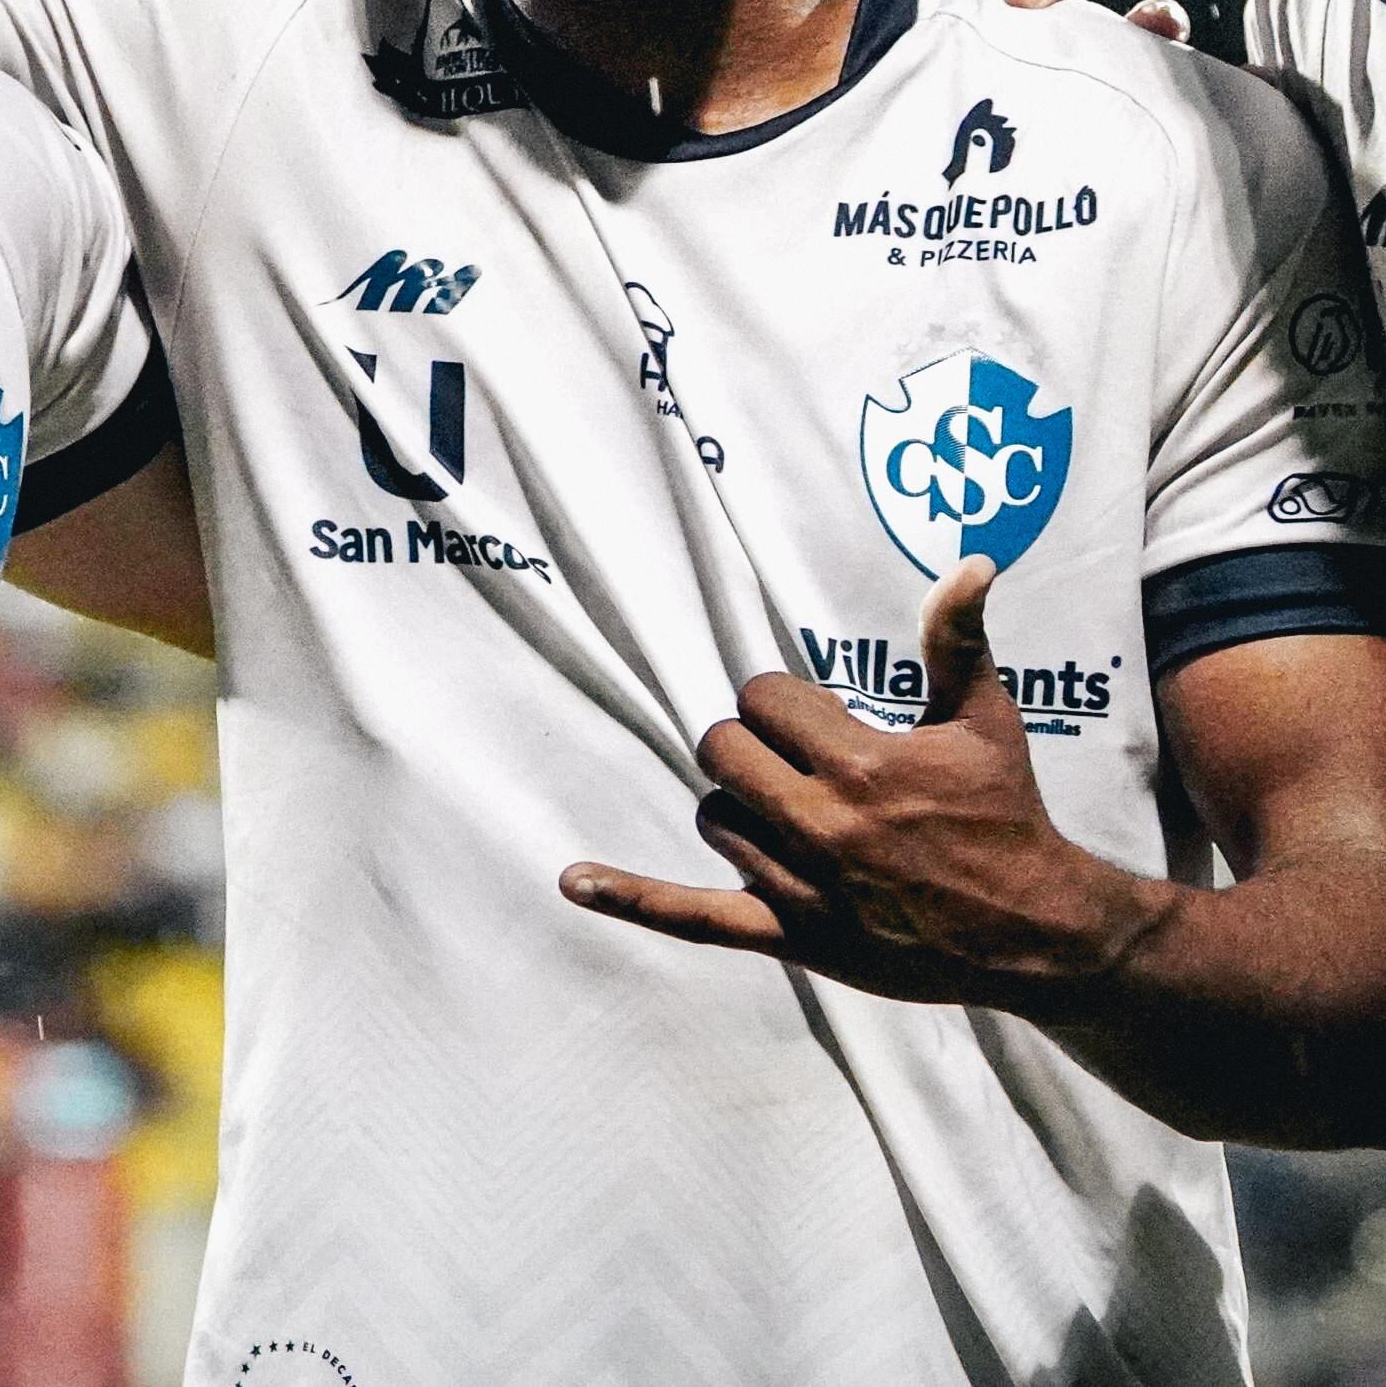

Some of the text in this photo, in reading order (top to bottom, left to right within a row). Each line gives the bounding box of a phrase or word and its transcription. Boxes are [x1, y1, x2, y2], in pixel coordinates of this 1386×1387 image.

[887, 247, 907, 267] &
[309, 519, 552, 584] San Marcos
[1024, 719, 1081, 737] emillas
[302, 1341, 357, 1387] EL DECA
